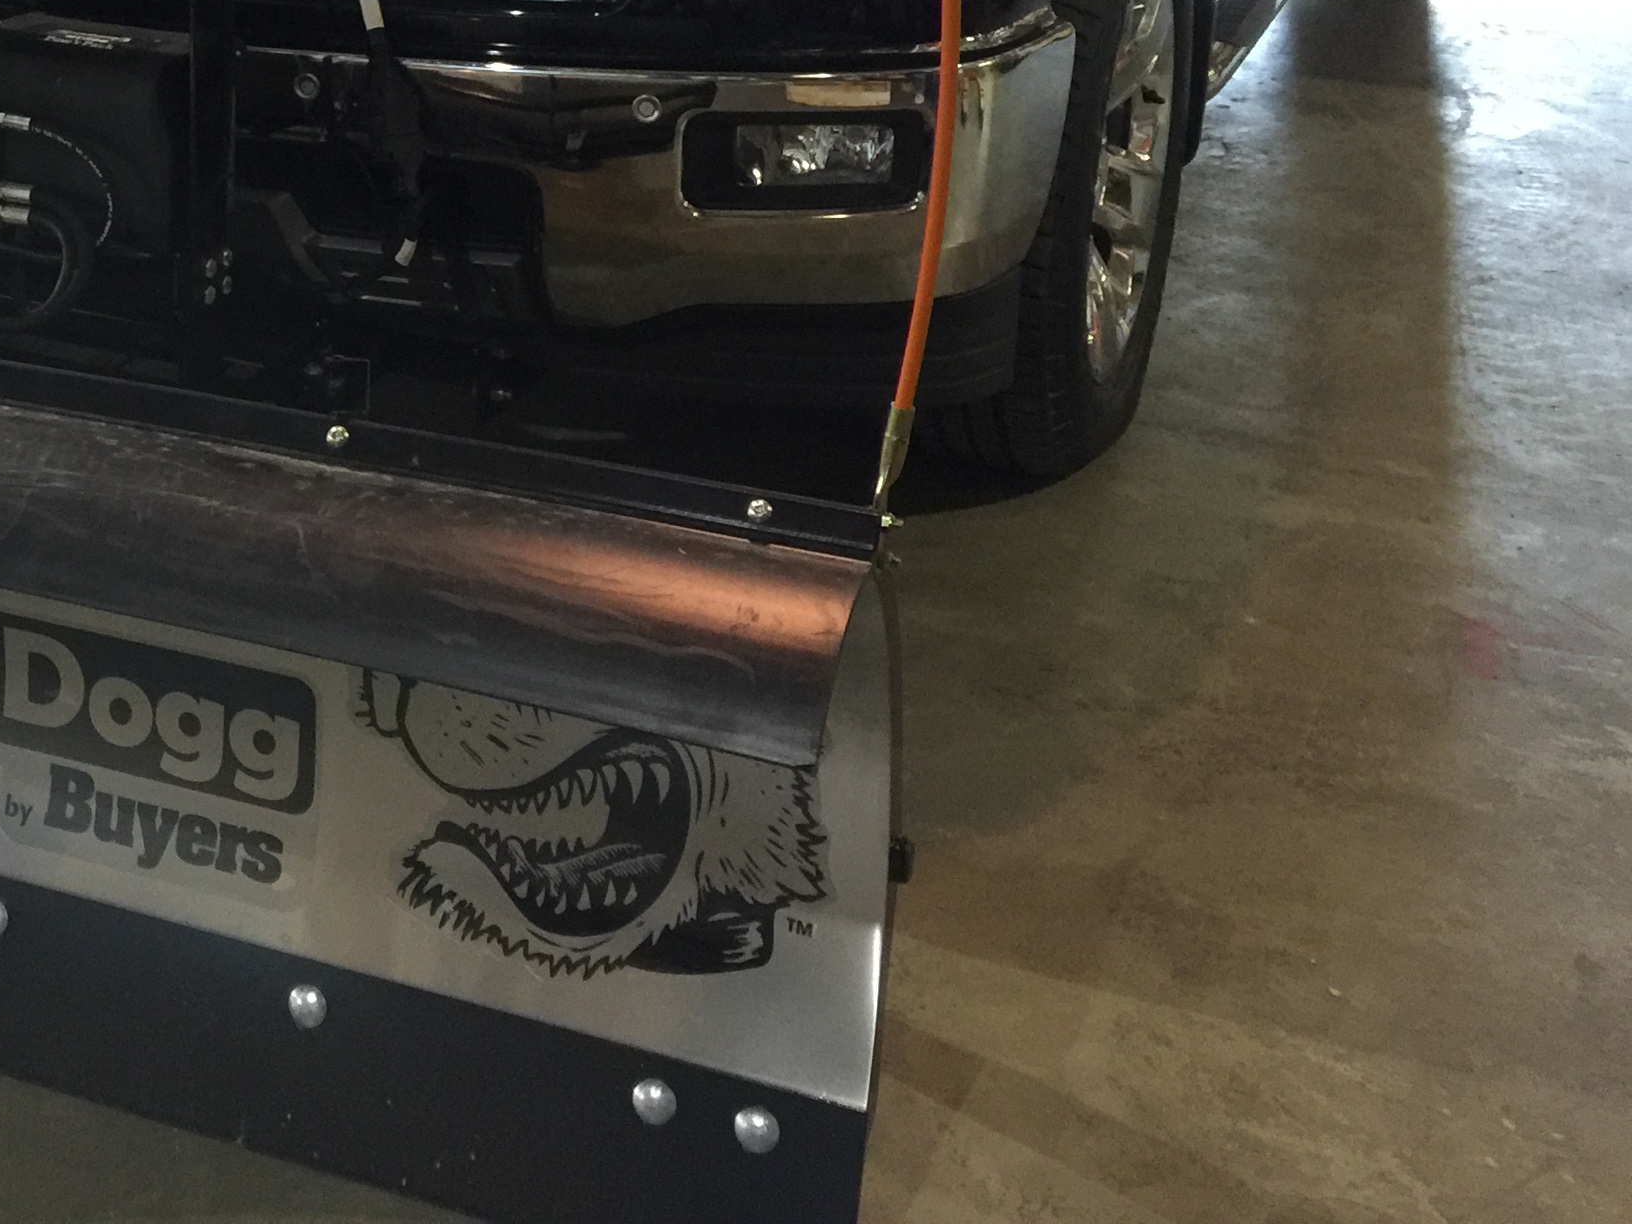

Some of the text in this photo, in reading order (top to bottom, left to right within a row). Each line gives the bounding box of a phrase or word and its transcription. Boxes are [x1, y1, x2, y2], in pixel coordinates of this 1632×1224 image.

[4, 763, 284, 884] by Buyers
[786, 917, 814, 938] TM
